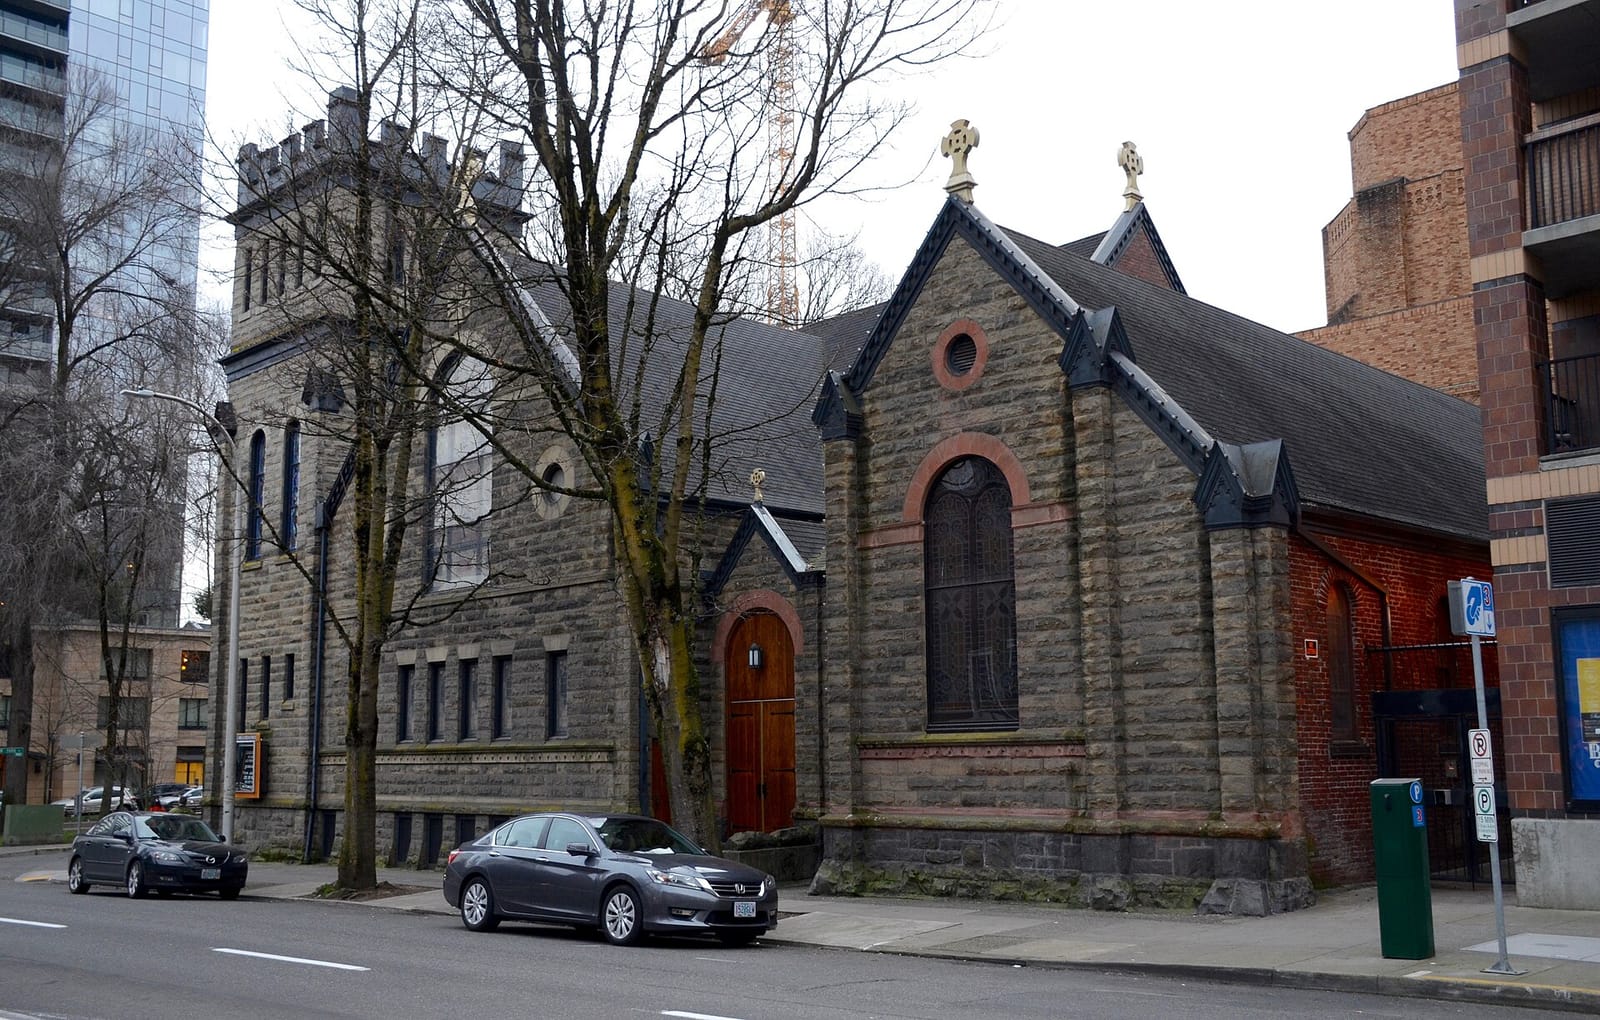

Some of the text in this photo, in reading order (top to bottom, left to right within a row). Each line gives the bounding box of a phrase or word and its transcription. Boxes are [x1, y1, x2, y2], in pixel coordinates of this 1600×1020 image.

[1483, 586, 1490, 606] 3
[1414, 785, 1420, 800] P
[1481, 794, 1488, 808] P
[1416, 808, 1423, 822] 3
